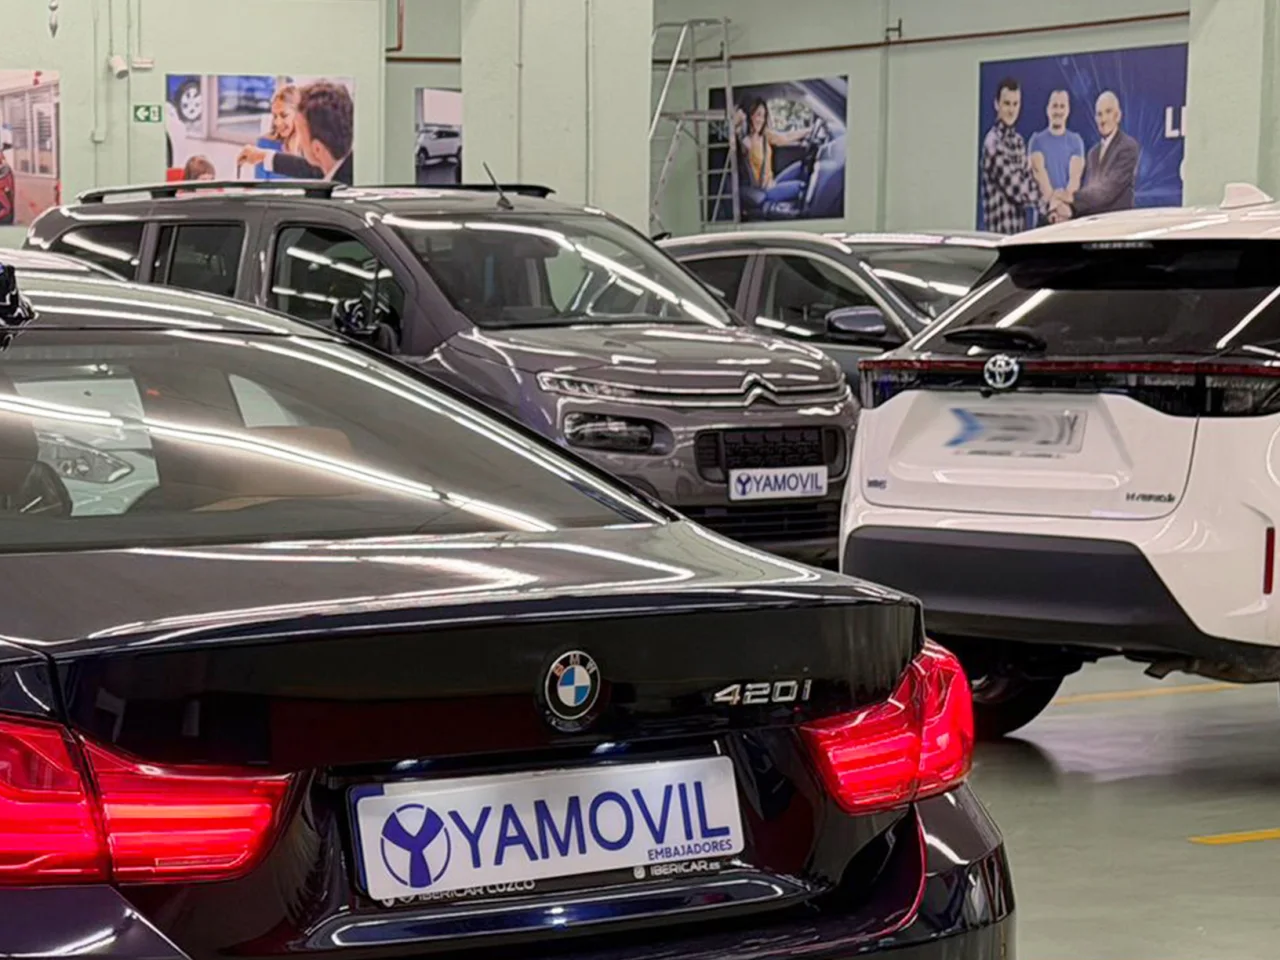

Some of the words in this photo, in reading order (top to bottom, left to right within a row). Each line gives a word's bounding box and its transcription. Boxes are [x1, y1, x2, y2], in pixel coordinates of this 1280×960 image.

[753, 472, 823, 493] YAMOVIL
[553, 653, 597, 677] BMW
[448, 781, 730, 869] YAMOVIL
[648, 839, 733, 861] EMBAJADORES
